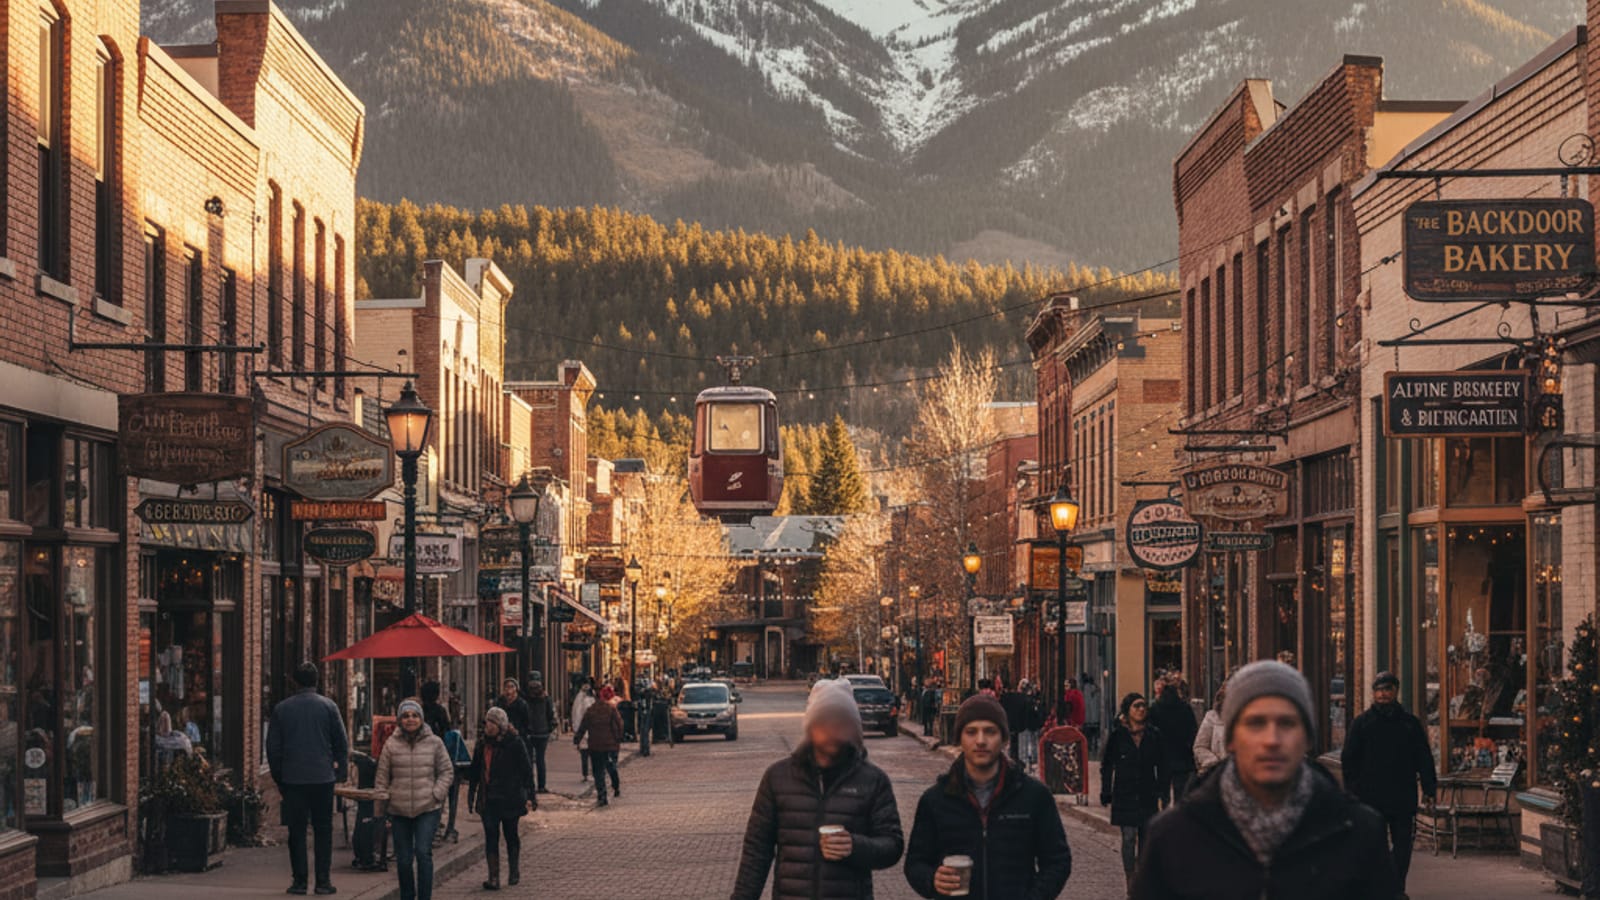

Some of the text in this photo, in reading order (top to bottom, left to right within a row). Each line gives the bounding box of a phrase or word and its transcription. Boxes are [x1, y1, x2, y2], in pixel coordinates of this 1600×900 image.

[1447, 209, 1584, 235] BACKDOOR
[1444, 244, 1575, 272] BAKERY
[1392, 382, 1449, 398] ALPINE
[1401, 408, 1412, 426] &
